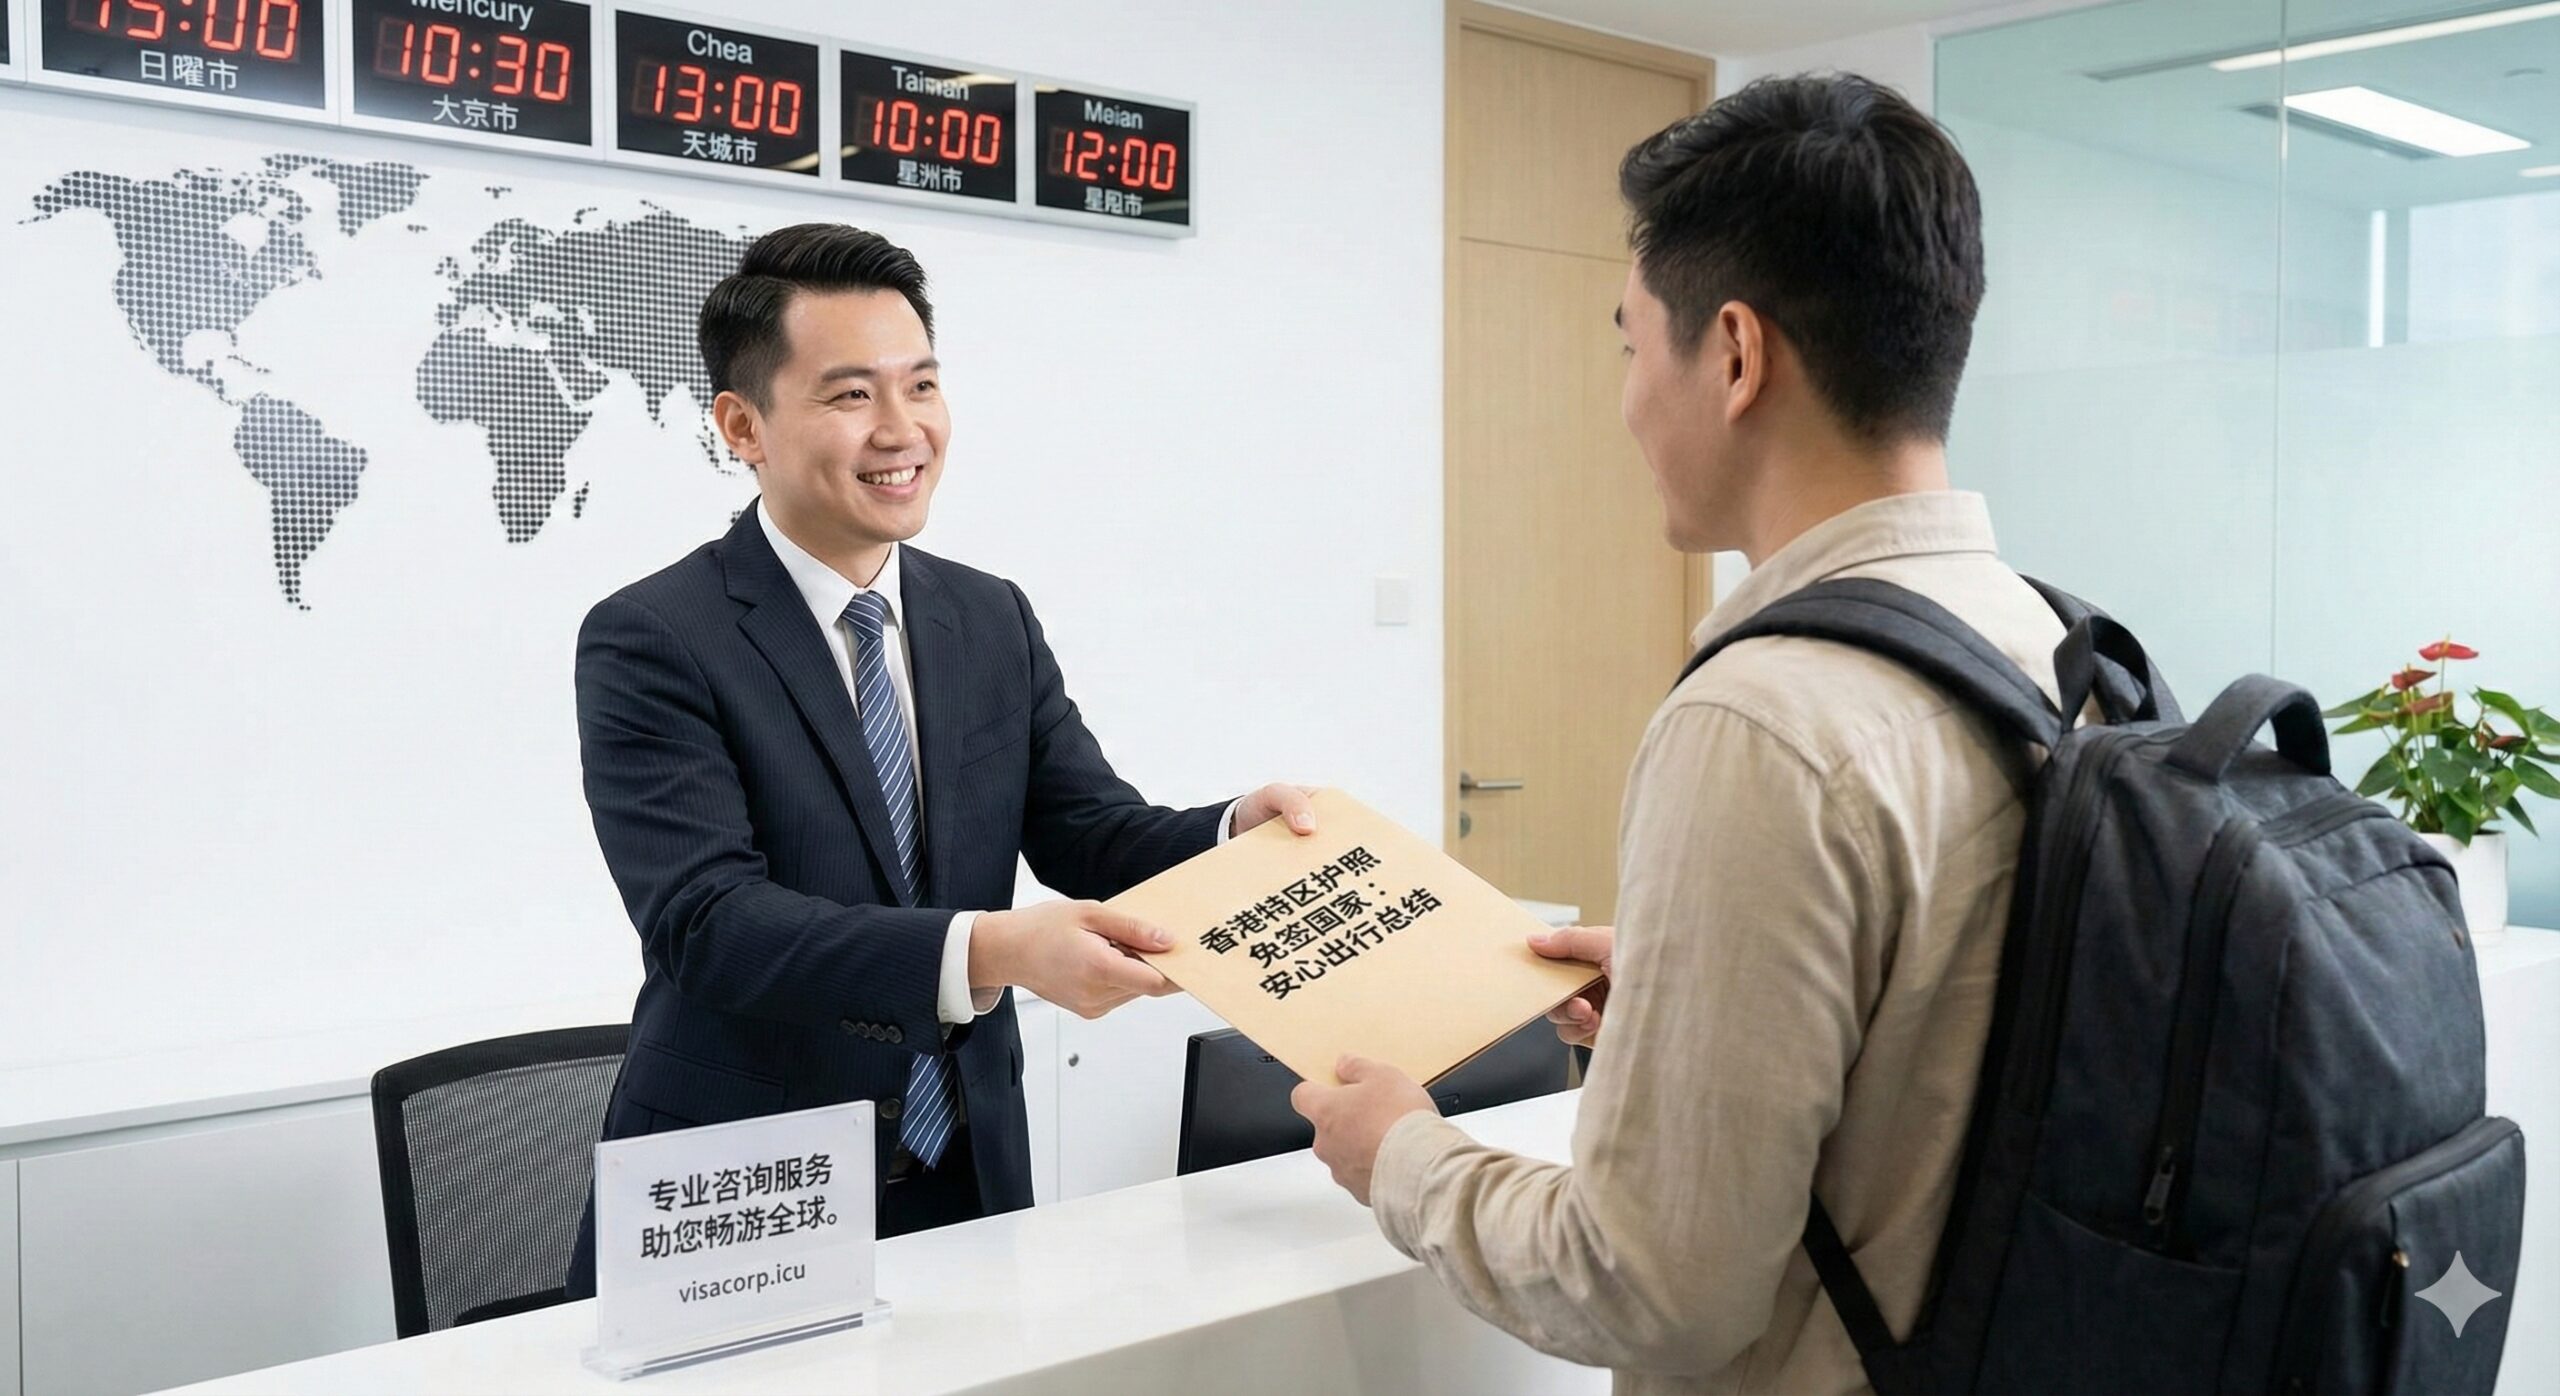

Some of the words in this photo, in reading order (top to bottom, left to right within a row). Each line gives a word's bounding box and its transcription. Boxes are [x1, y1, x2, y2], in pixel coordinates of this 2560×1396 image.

[140, 49, 239, 91] 日曜市
[401, 24, 570, 100] 10:30
[687, 29, 753, 64] Chea
[432, 94, 519, 131] 大京市
[654, 65, 801, 135] 13:00
[681, 130, 758, 164] 天城市
[873, 100, 1001, 164] 10:00
[1063, 131, 1177, 191] 12:00
[1199, 846, 1381, 955] 香港特区护照
[1249, 881, 1386, 969] 免签国家：
[1259, 887, 1442, 1000] 安心出行总结
[648, 1153, 833, 1212] 专业咨询服务
[640, 1195, 838, 1260] 助您畅游全球。
[679, 1263, 806, 1303] visacorp.icu
